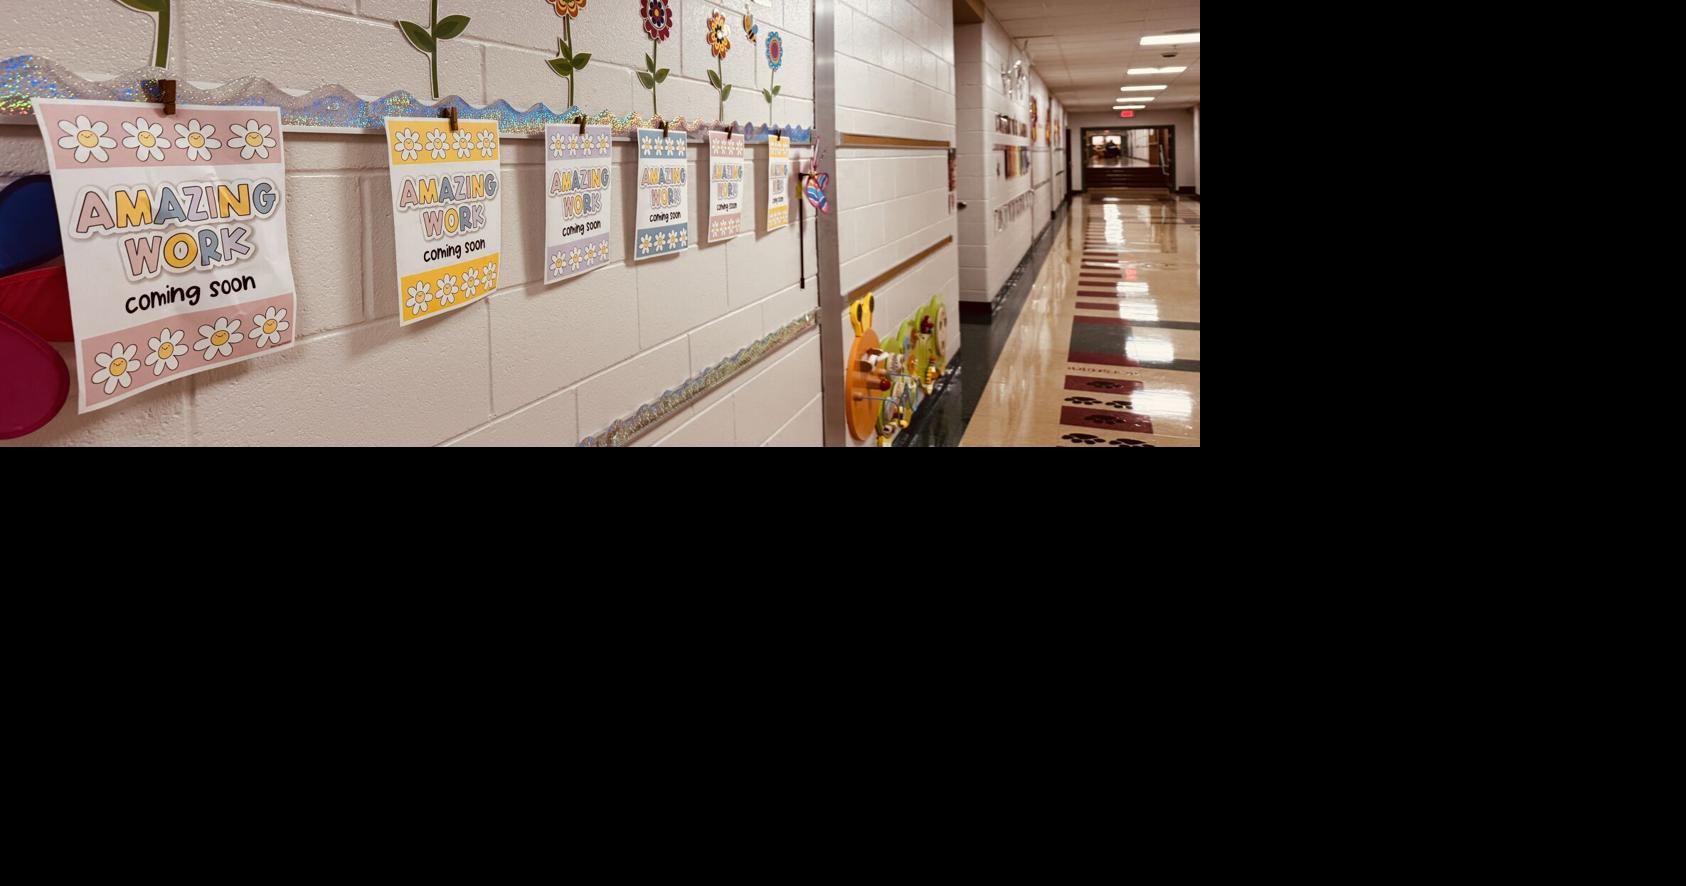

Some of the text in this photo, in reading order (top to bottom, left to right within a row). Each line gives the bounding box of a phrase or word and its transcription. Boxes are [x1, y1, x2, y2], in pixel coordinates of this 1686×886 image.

[400, 173, 497, 208] AMAZING
[550, 168, 609, 195] AMAZING
[641, 167, 686, 186] AMAZING
[76, 182, 277, 234] AMAZING
[563, 192, 601, 217] WORK
[422, 204, 485, 238] WORK
[562, 220, 602, 237] coming soon
[124, 226, 251, 277] WORK
[423, 238, 486, 262] coming soon
[125, 275, 257, 314] coming soon
